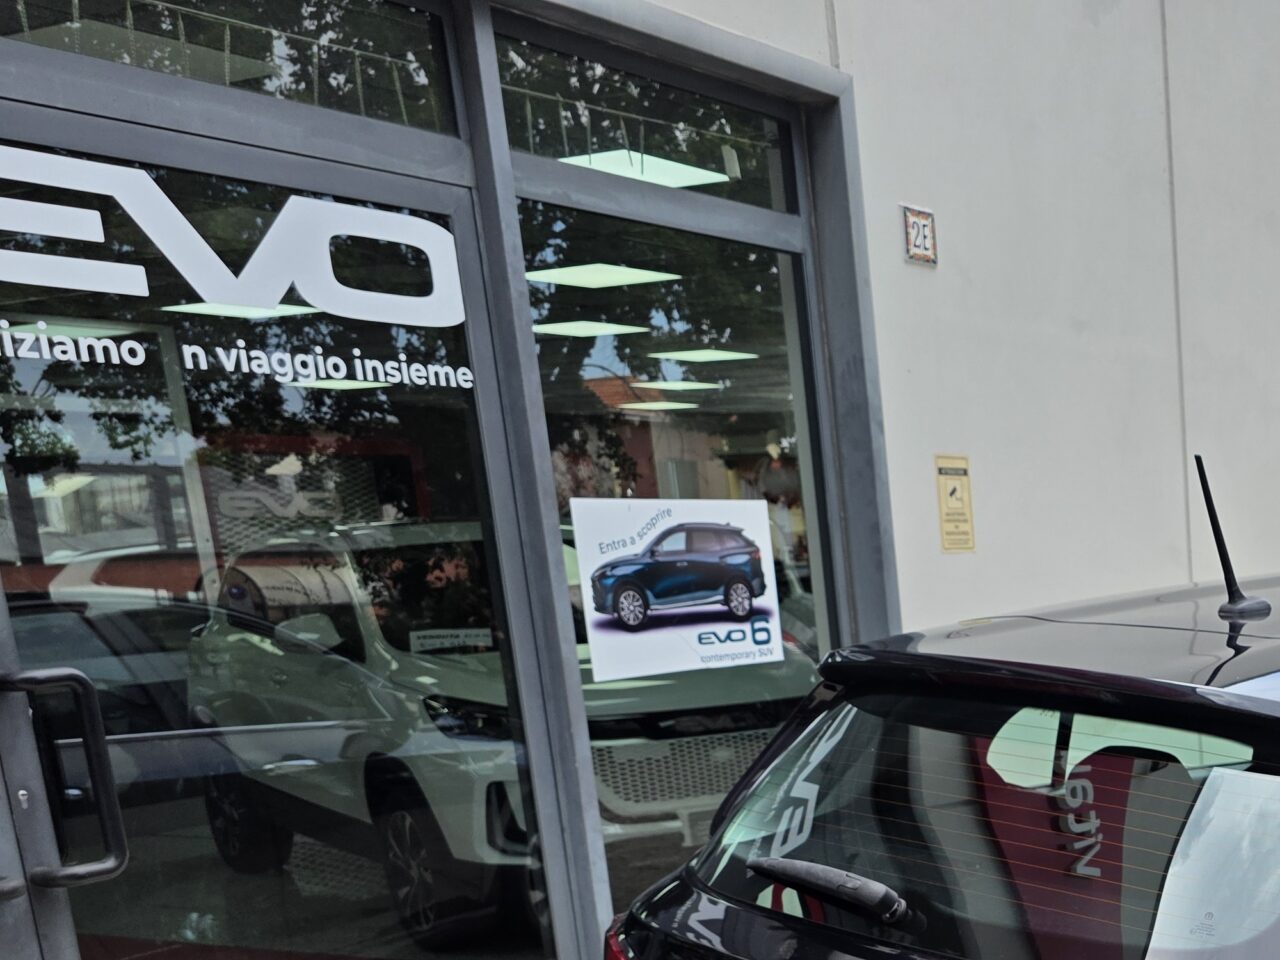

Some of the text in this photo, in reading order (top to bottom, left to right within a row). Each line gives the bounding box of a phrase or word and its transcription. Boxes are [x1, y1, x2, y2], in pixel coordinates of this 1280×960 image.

[0, 144, 466, 328] EVO
[0, 319, 146, 366] iziamo
[215, 339, 347, 383] viaggio
[352, 348, 474, 389] insieme
[598, 507, 673, 555] Entra a scoprire
[698, 616, 772, 646] EVO 6
[700, 647, 775, 664] contemporary SUV
